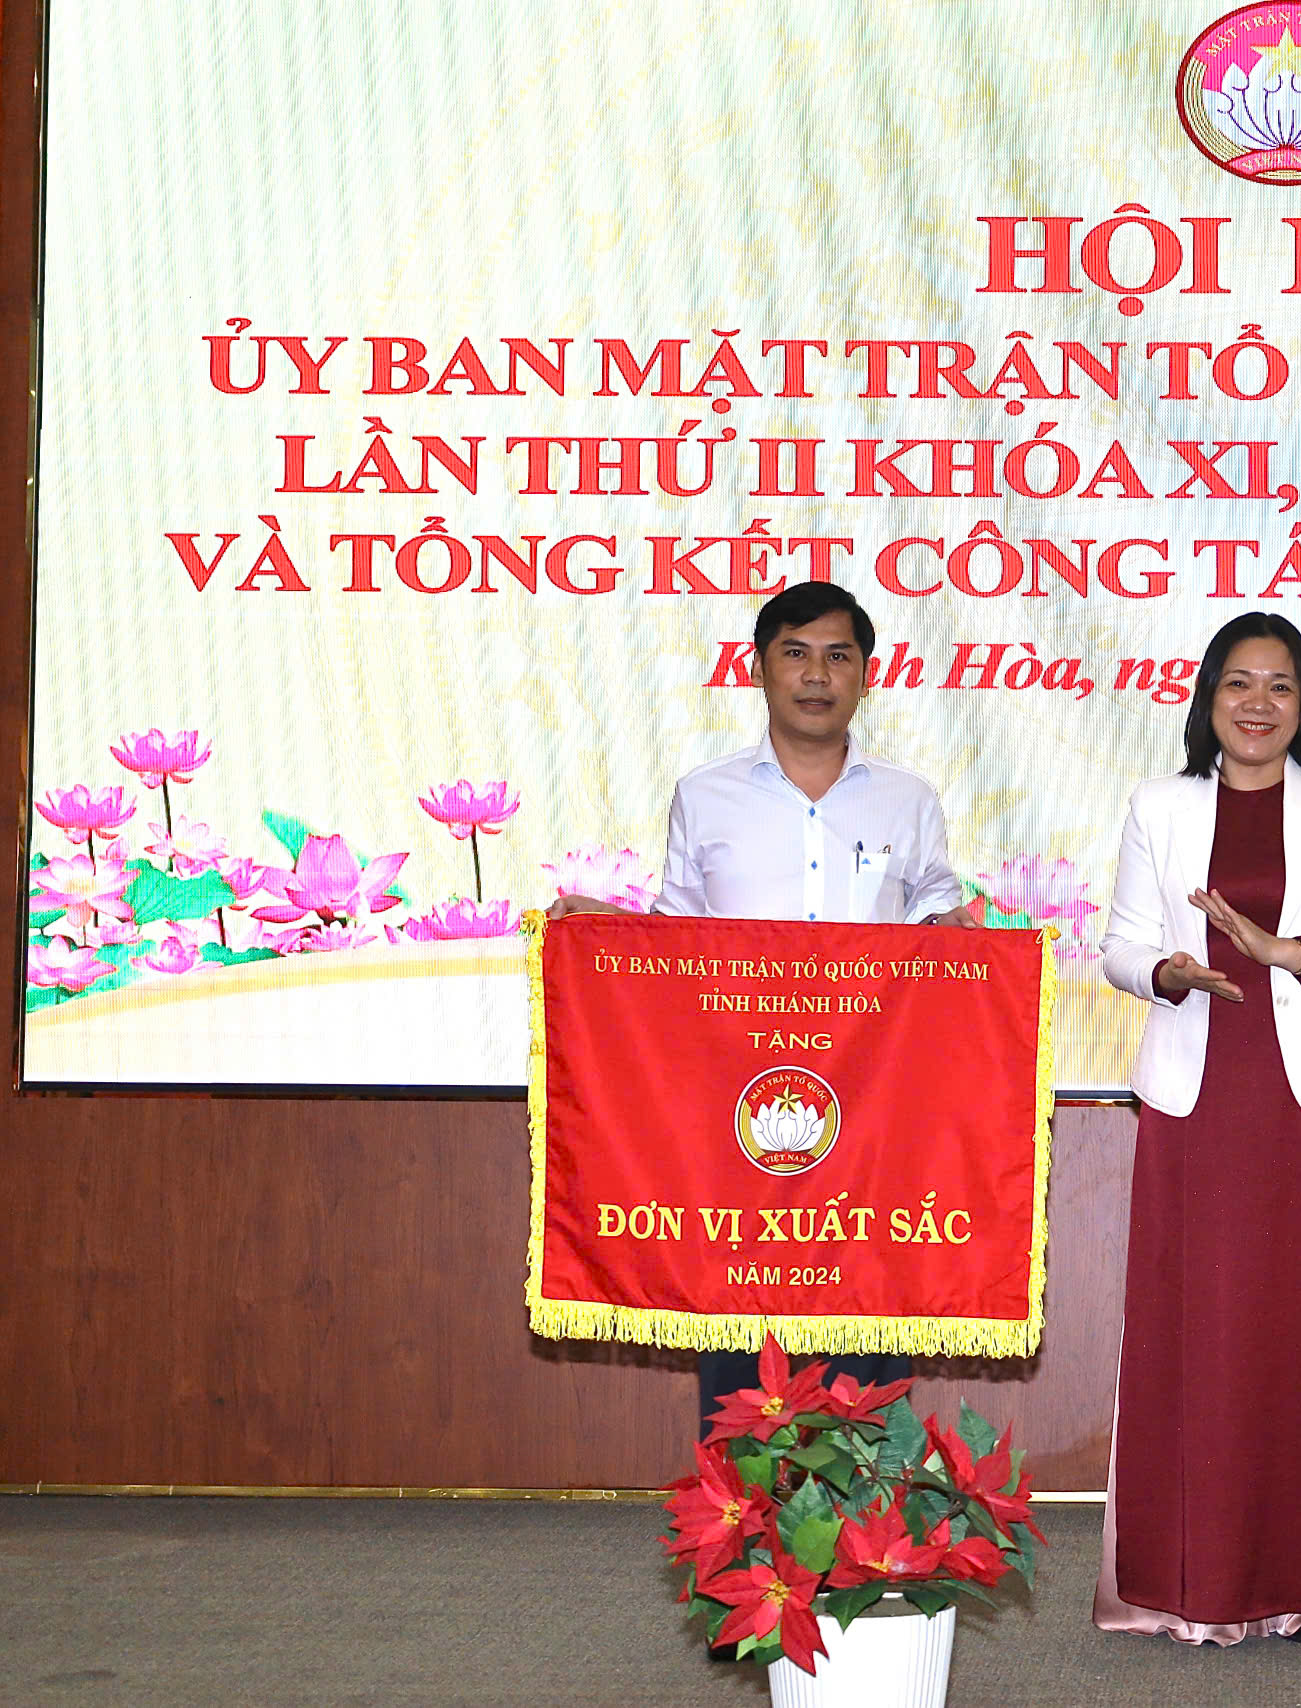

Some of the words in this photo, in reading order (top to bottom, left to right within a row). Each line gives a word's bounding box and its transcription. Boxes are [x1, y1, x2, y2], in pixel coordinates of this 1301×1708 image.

[976, 203, 1231, 316] HỘI
[202, 318, 348, 394] ỦY
[363, 337, 574, 396] BAN
[593, 329, 828, 414] MẶT
[845, 331, 1121, 416] TRẬN
[1146, 324, 1288, 400] TỔ
[275, 416, 486, 495] LẦN
[506, 419, 736, 496] THỨ
[749, 438, 824, 496] II
[846, 422, 1150, 499] KHÓA
[1166, 440, 1298, 512] XI,
[164, 515, 311, 592] VÀ
[330, 516, 624, 594] TỔNG
[644, 518, 853, 595] KẾT
[876, 520, 1175, 599] CÔNG
[938, 643, 1094, 700] Hòa,
[1114, 658, 1200, 704] ng
[594, 948, 623, 973] ỦY
[629, 956, 671, 975] BAN
[677, 954, 722, 982] MẶT
[727, 956, 785, 982] TRẬN
[790, 953, 818, 979] TỔ
[824, 953, 883, 983] QUỐC
[889, 956, 938, 983] VIỆT
[943, 961, 989, 981] NAM
[698, 988, 751, 1012] TỈNH
[756, 990, 832, 1013] KHÁNH
[837, 991, 882, 1013] HÒA
[747, 1029, 834, 1053] TẶNG
[597, 1200, 685, 1241] ĐƠN
[697, 1207, 743, 1250] VỊ
[757, 1192, 876, 1243] XUẤT
[889, 1190, 972, 1245] SẮC
[727, 1264, 781, 1286] NĂM
[788, 1266, 842, 1287] 2024
